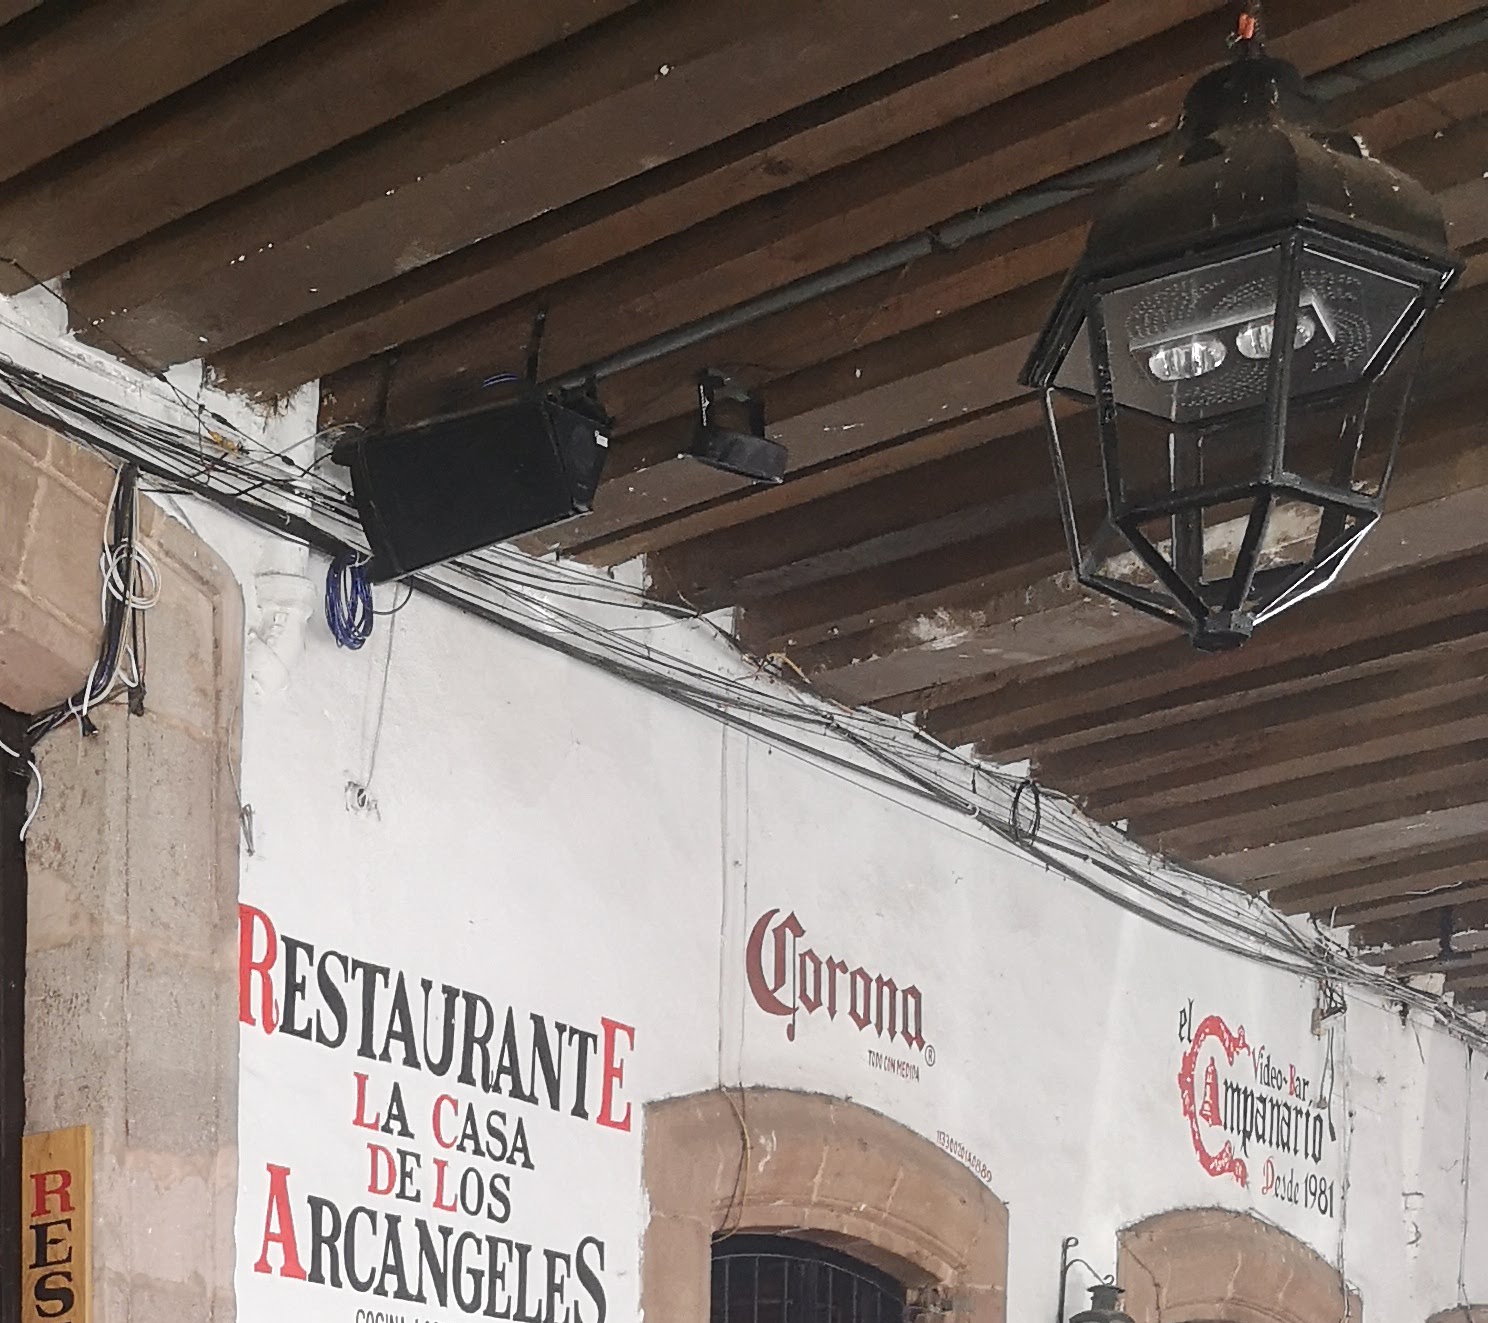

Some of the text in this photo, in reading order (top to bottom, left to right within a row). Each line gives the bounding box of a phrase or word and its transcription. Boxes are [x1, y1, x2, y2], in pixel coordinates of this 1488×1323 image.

[238, 903, 635, 1132] RESTAURANTE
[746, 908, 926, 1052] Corona
[1178, 997, 1194, 1044] el
[868, 1050, 920, 1082] TODO CON MEDIDA
[353, 1072, 534, 1170] LA CASA
[367, 1142, 511, 1223] DE LOS
[1262, 1156, 1334, 1218] Desde 1981
